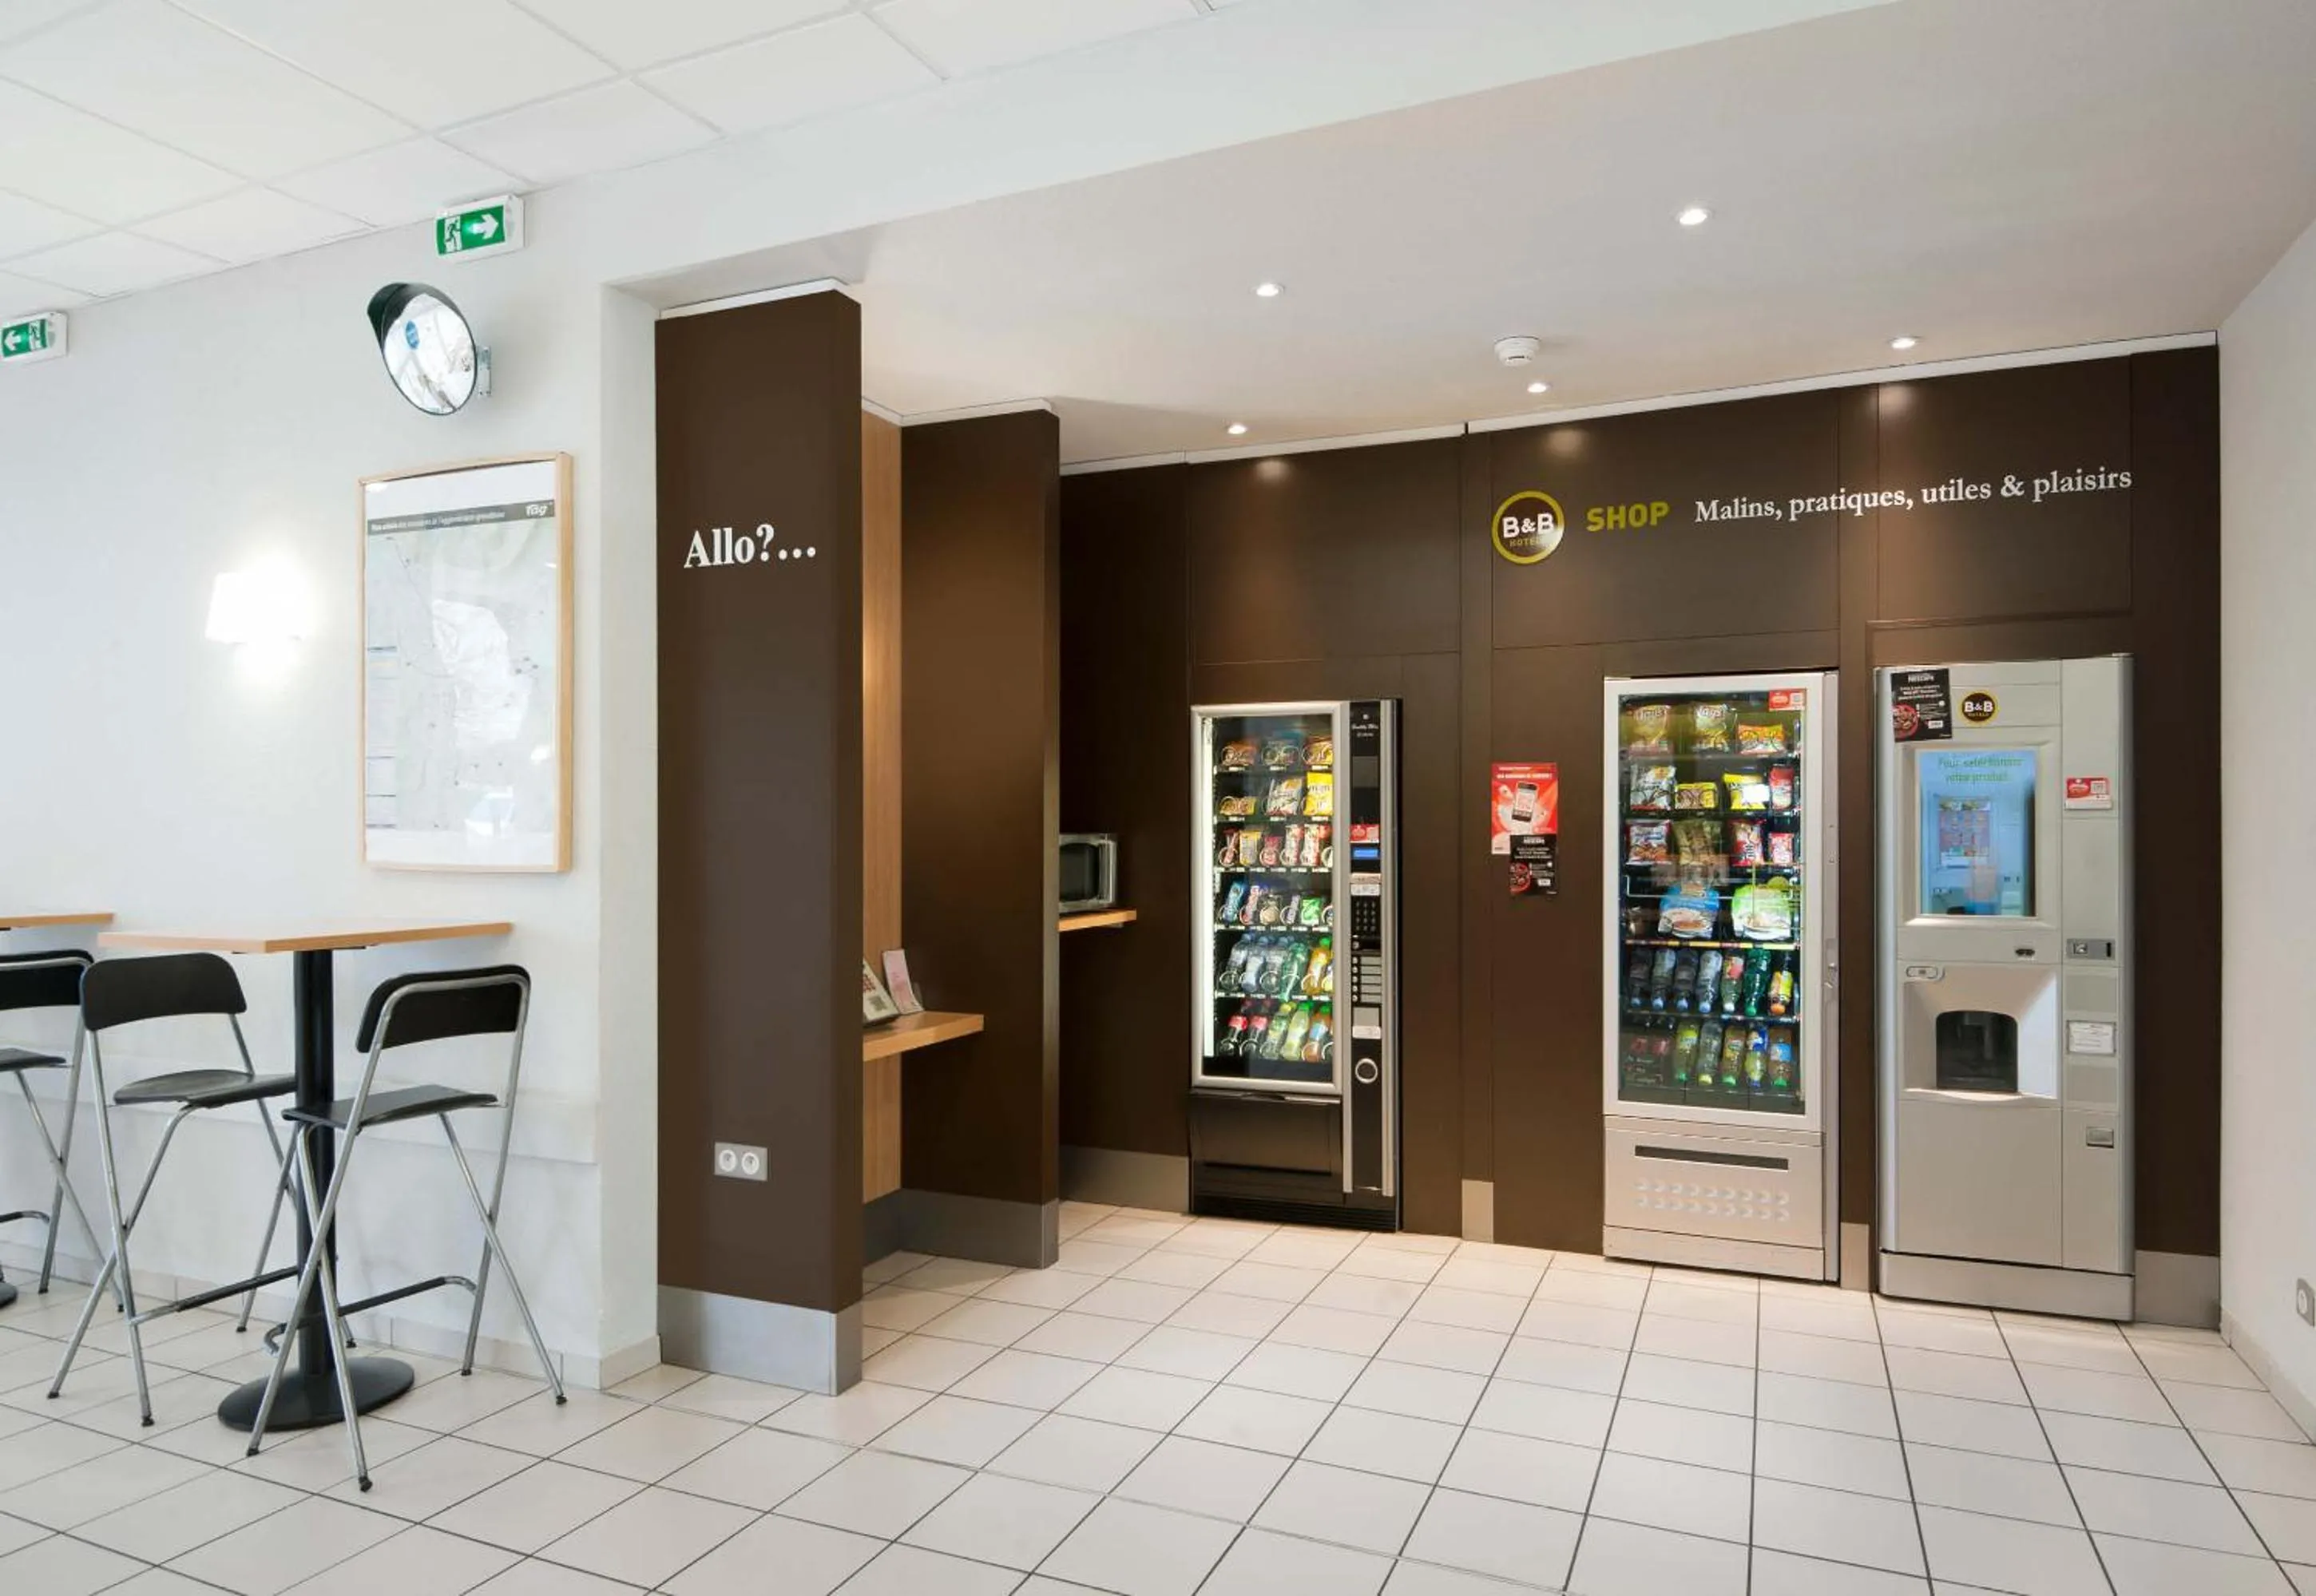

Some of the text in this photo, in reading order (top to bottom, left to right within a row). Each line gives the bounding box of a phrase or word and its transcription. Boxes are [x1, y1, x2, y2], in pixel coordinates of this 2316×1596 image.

[1695, 466, 2132, 522] Malins, pratiques, utiles & plaisirs
[1502, 513, 1554, 539] B&B
[1586, 501, 1669, 532] SHOP
[1965, 701, 1994, 712] B&B
